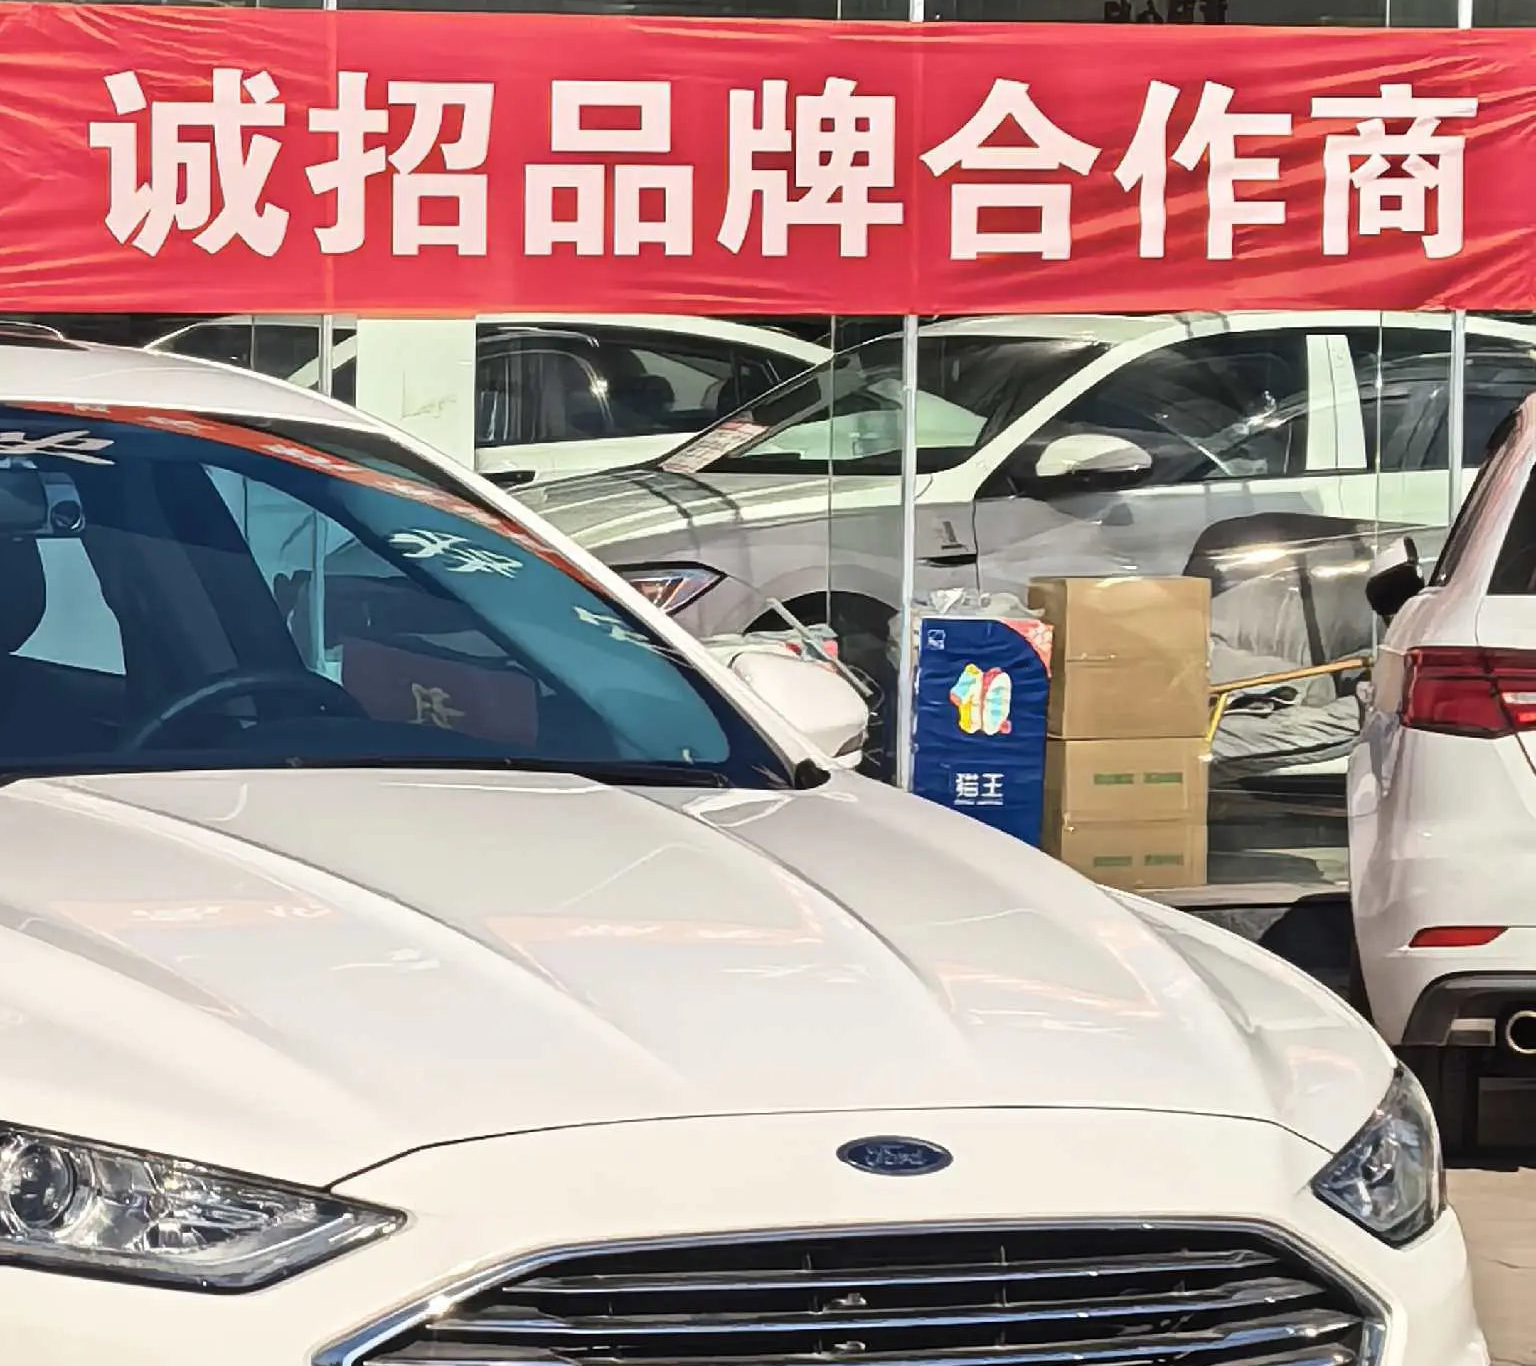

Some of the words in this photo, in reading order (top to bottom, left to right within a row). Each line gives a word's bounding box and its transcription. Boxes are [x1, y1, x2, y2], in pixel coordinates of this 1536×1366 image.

[89, 68, 1478, 261] 诚招品牌合作商
